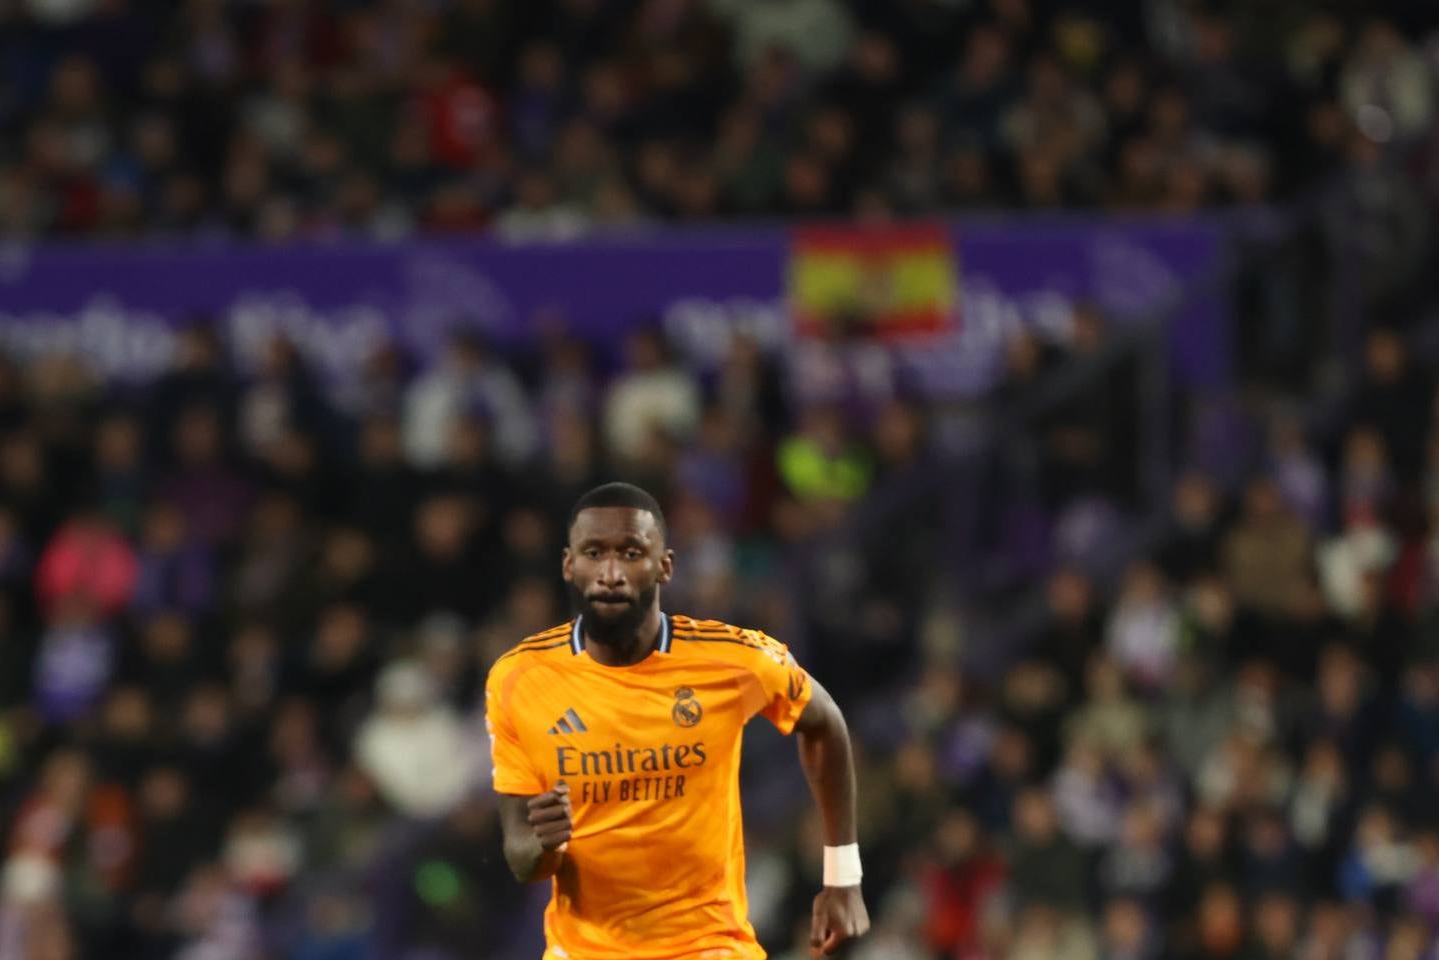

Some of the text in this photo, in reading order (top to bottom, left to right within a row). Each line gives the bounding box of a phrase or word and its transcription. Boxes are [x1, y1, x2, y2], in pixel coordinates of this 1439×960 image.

[557, 742, 706, 776] Emirates
[582, 775, 686, 803] FLY BETTER
